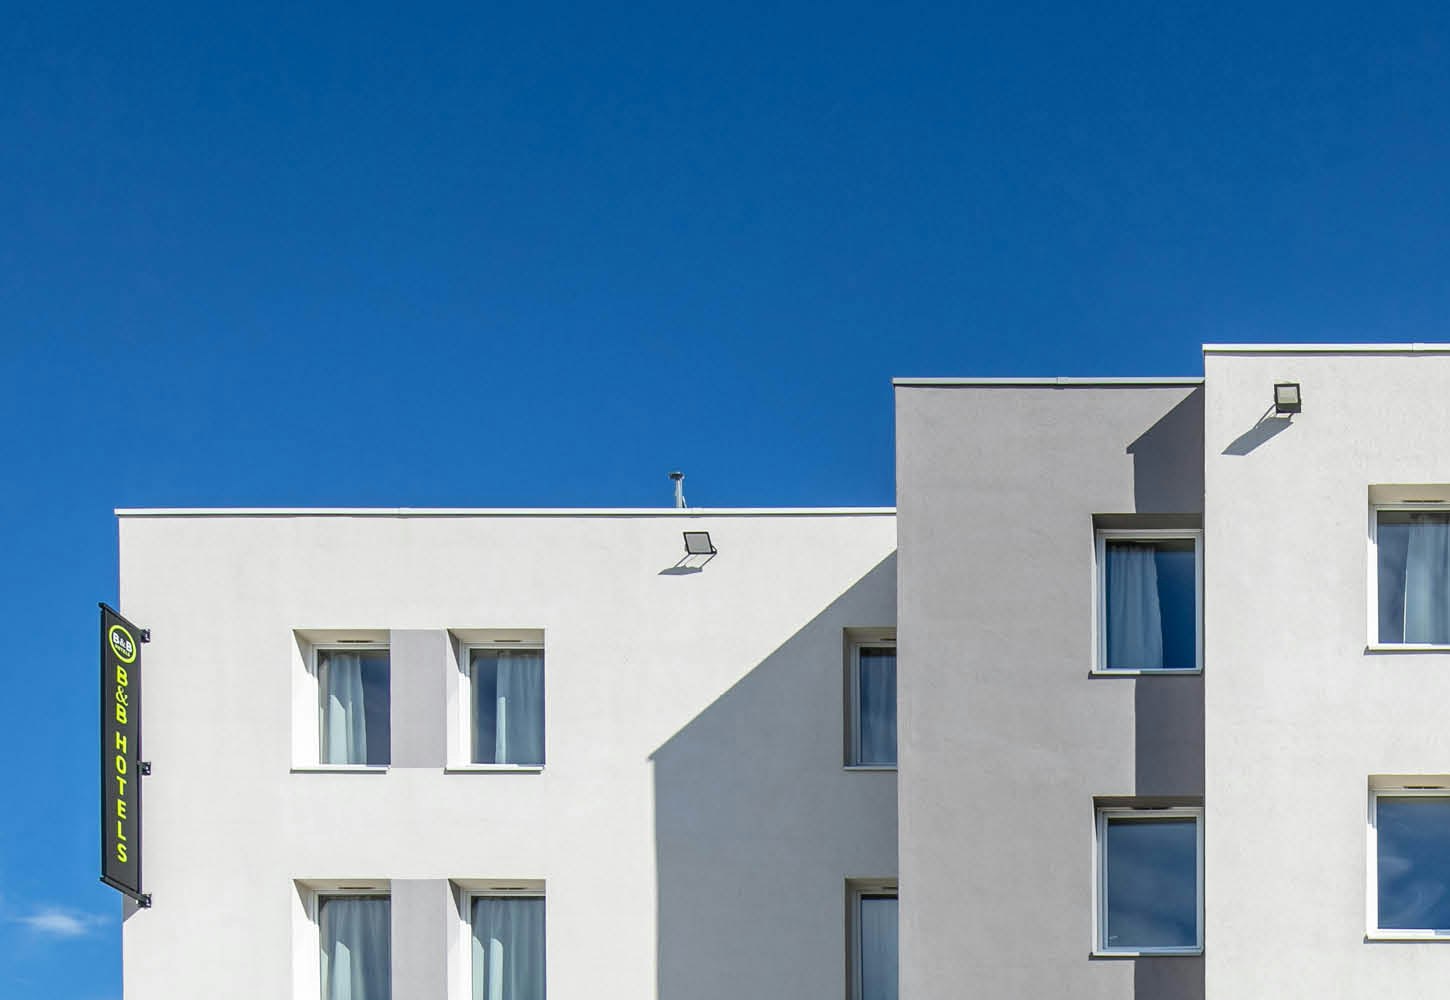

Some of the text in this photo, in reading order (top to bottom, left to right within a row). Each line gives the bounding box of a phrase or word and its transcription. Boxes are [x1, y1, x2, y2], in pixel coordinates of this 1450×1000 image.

[112, 632, 132, 653] B&B
[115, 665, 129, 863] B&B HOTELS
